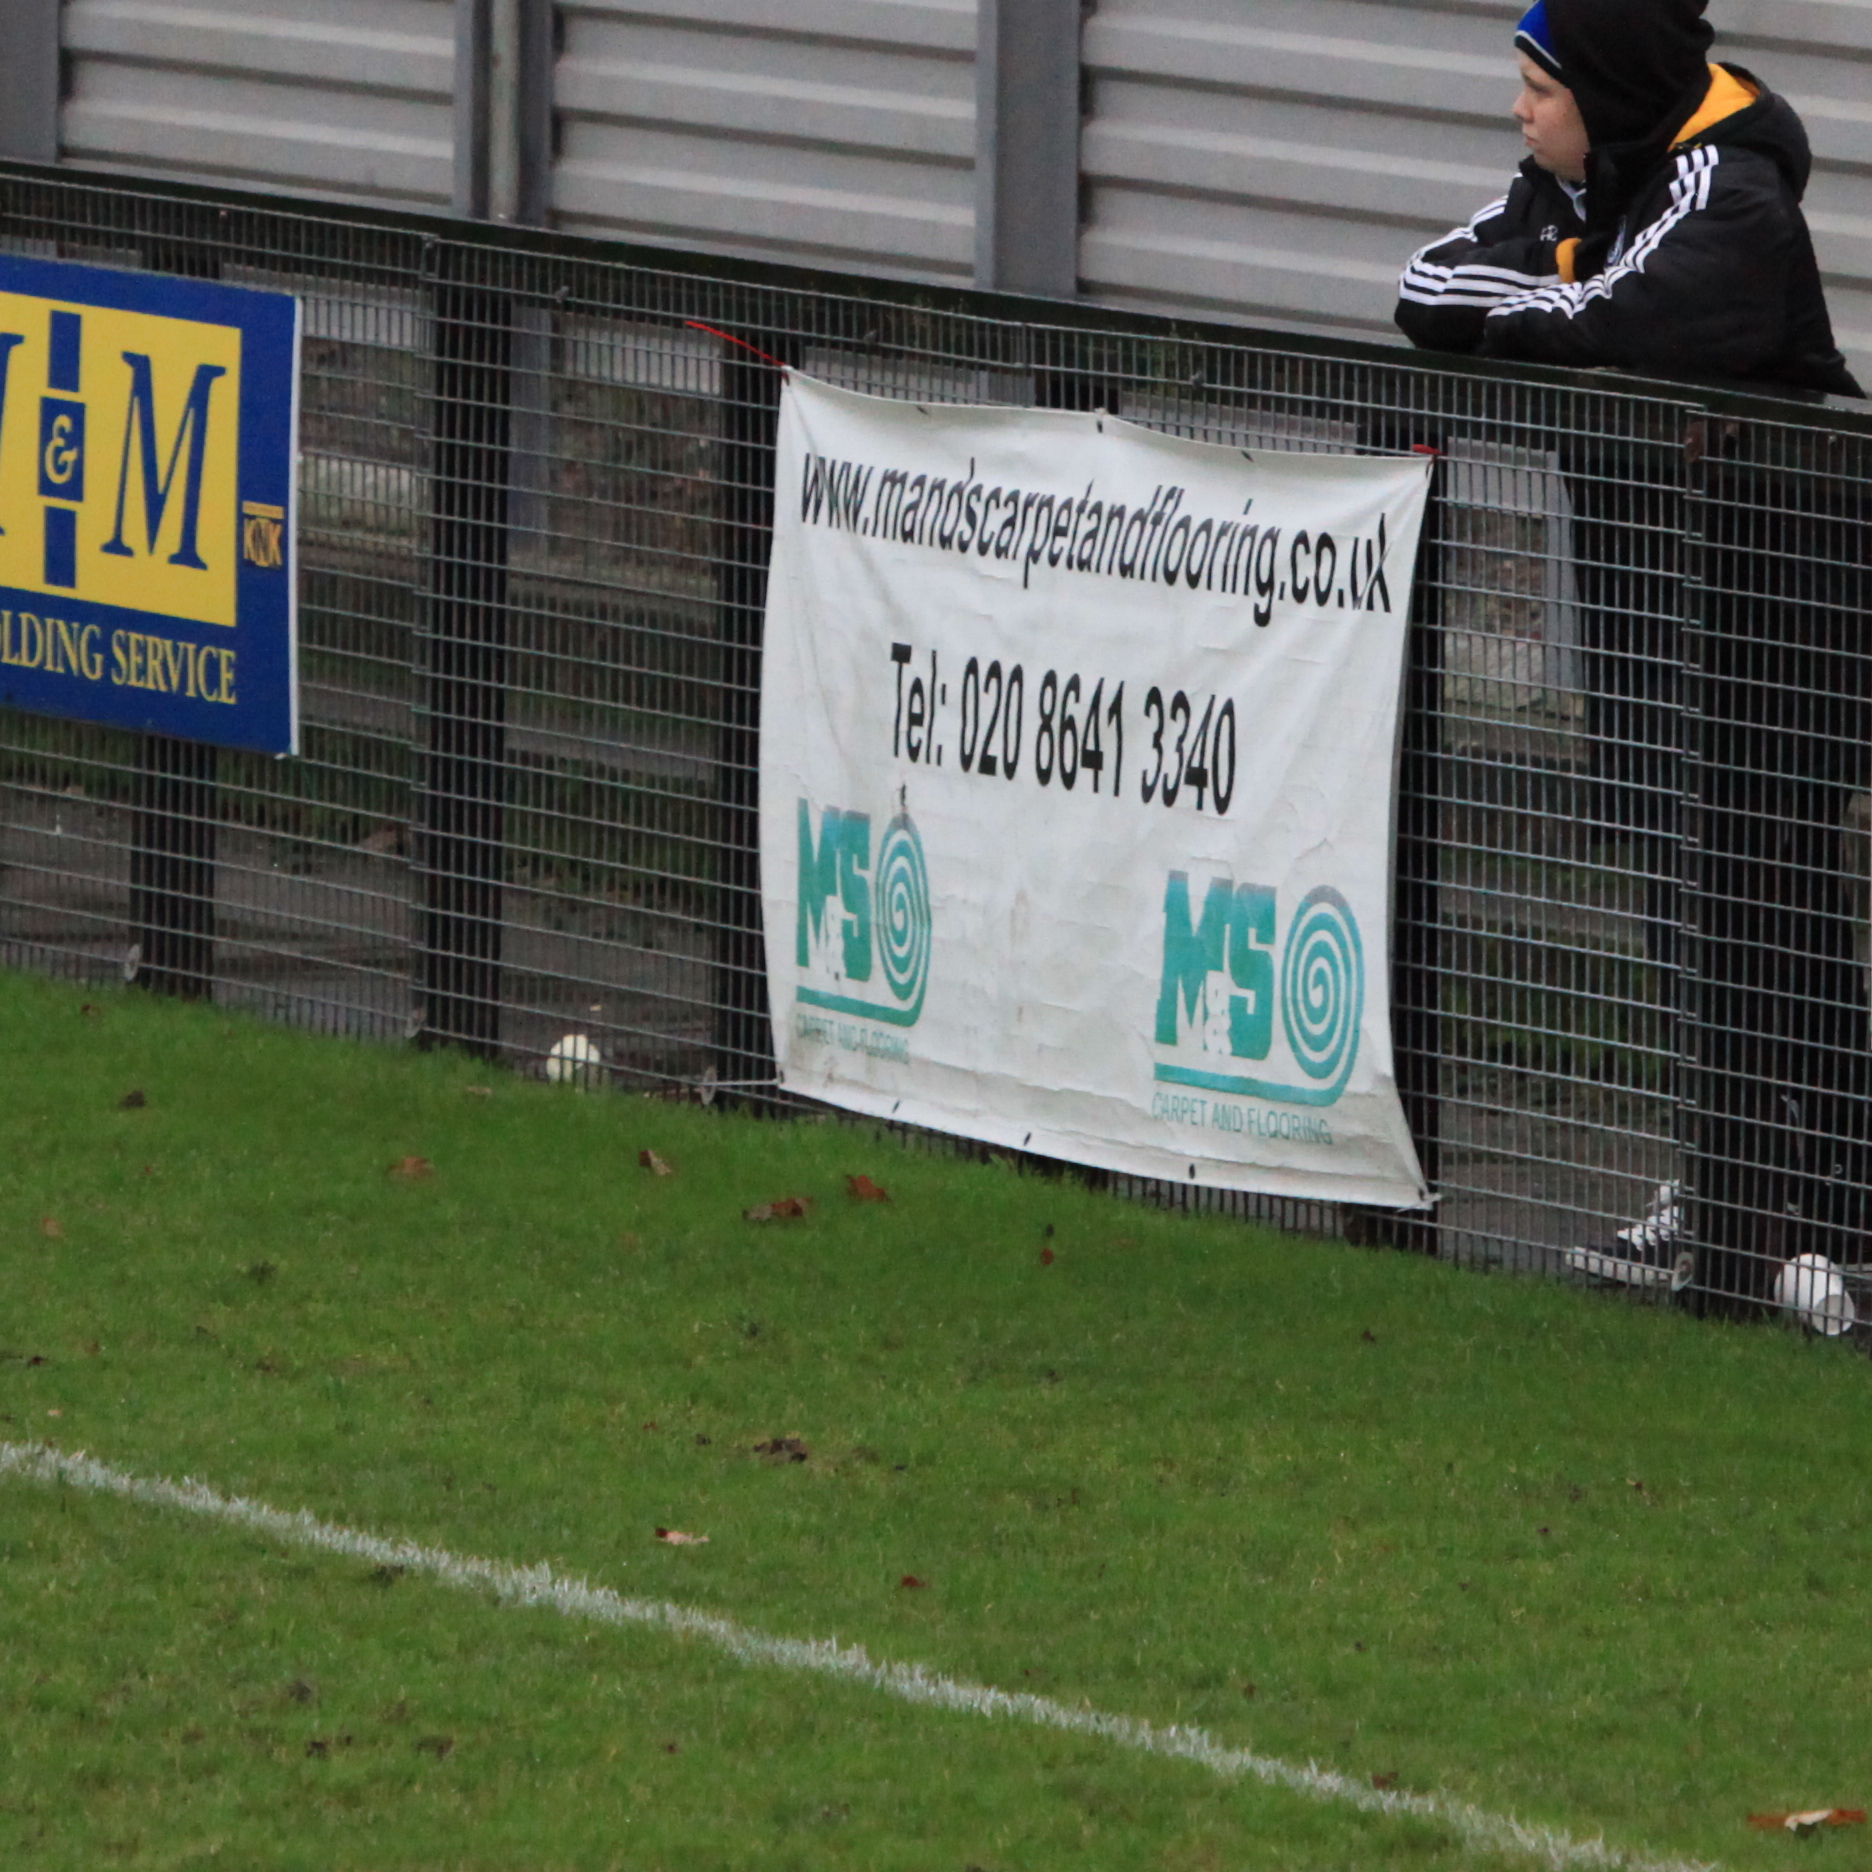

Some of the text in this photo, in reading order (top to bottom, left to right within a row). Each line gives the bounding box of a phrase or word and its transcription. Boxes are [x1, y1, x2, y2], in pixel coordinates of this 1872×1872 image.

[111, 628, 238, 704] SERVICE
[890, 641, 1235, 816] Tel: 020 8641 3340
[1152, 1091, 1334, 1146] CARPET AND FLOORING
